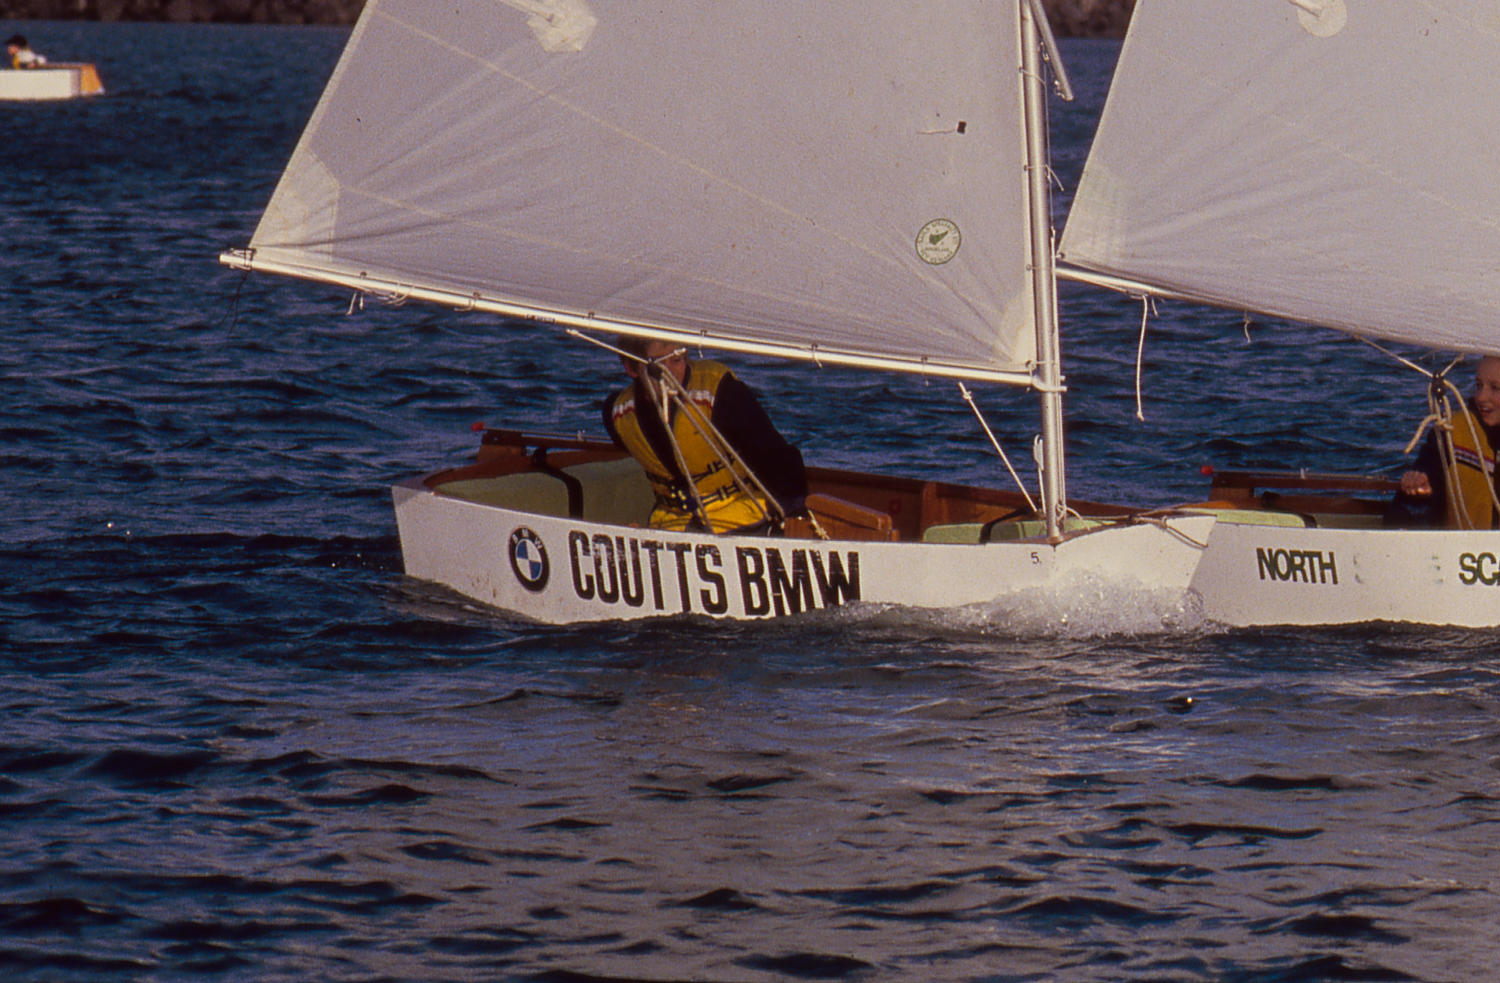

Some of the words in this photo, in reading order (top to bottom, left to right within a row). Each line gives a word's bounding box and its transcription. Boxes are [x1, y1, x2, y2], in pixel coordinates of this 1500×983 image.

[568, 529, 729, 615] COUTTS
[735, 546, 862, 617] BMW
[1256, 547, 1339, 585] NORTH
